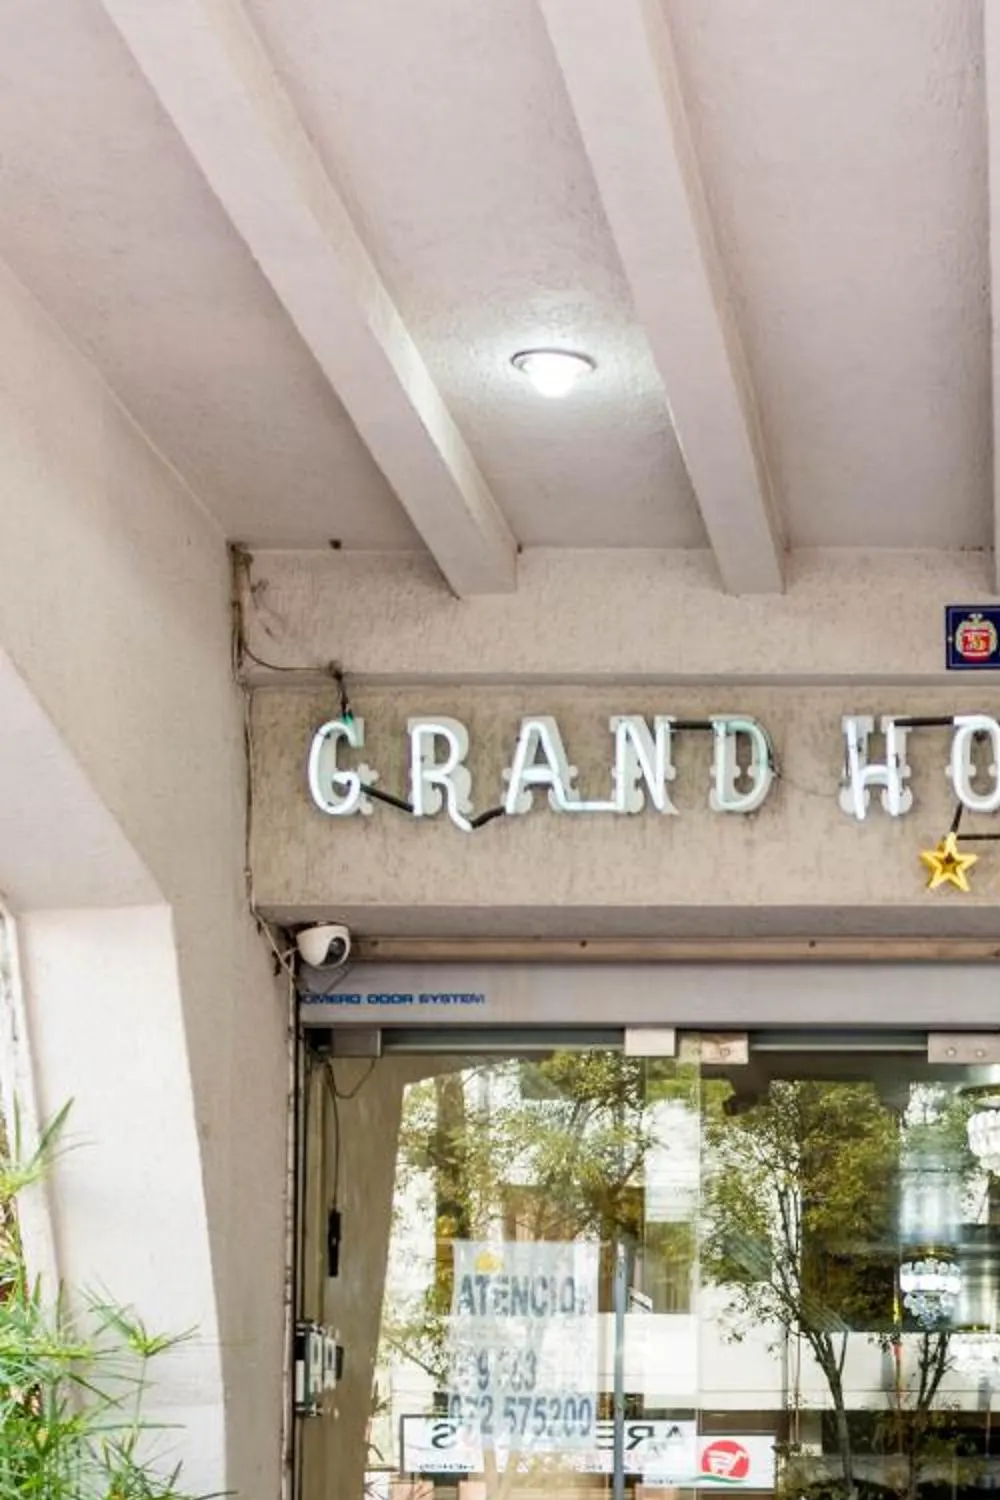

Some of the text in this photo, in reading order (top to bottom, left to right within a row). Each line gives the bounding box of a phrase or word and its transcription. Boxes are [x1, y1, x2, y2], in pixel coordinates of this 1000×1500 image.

[307, 713, 781, 832] GRAND
[367, 993, 413, 1005] DOOR
[418, 993, 486, 1005] SYSTEM
